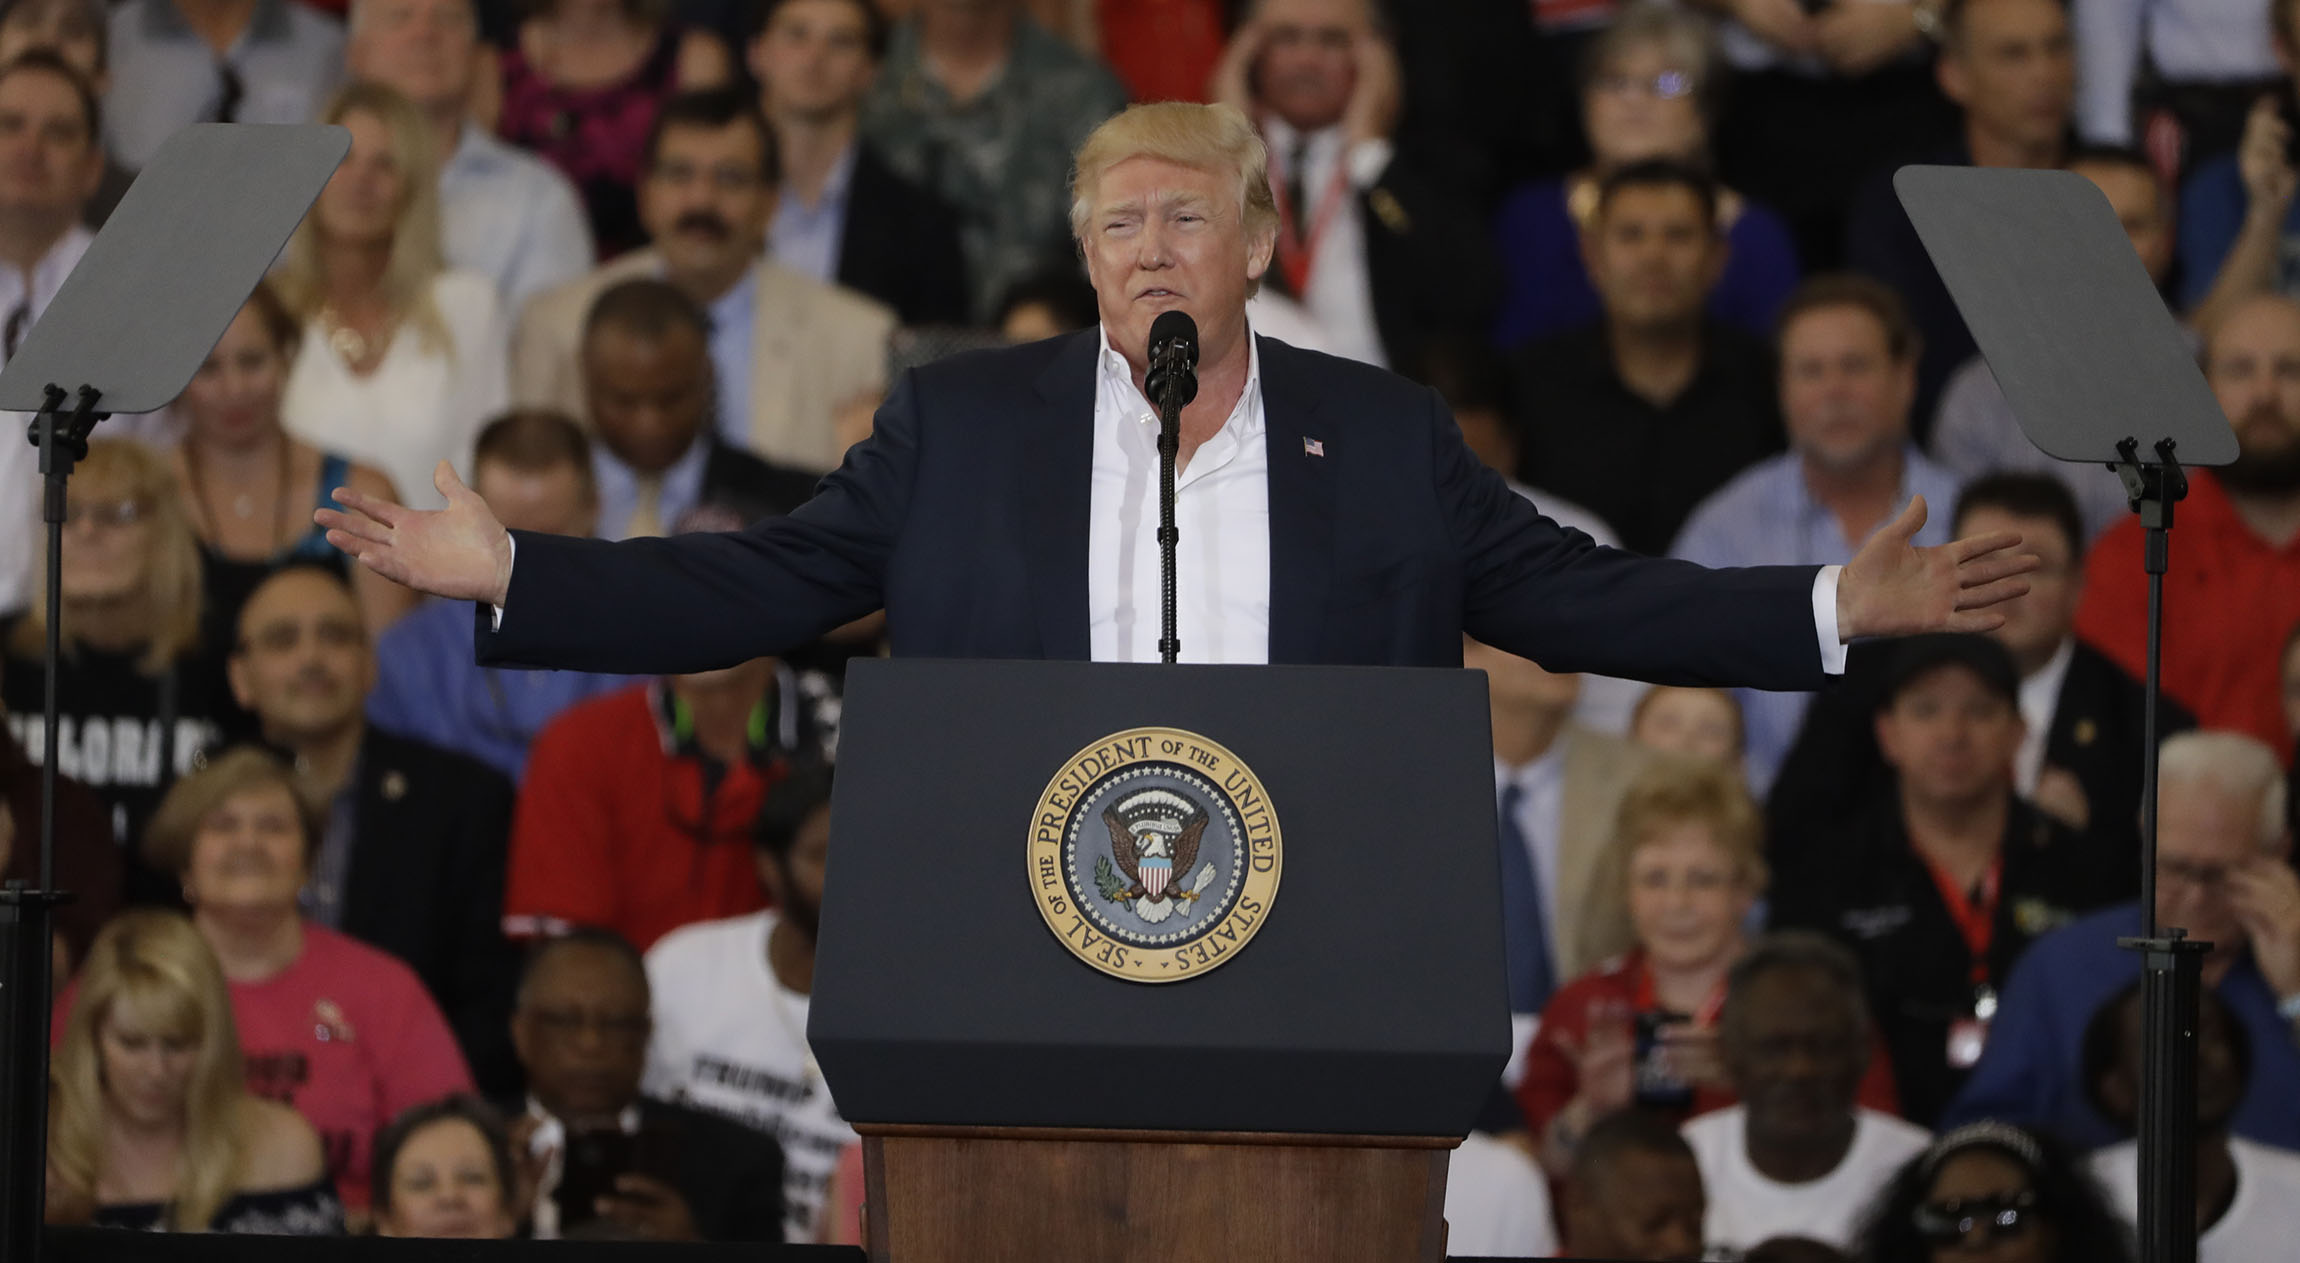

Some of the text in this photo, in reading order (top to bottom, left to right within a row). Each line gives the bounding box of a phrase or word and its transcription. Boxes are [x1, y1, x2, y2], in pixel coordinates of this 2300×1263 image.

[1037, 736, 1274, 971] SEAL OF THE PRESIDENT OF THE UNITED STATES
